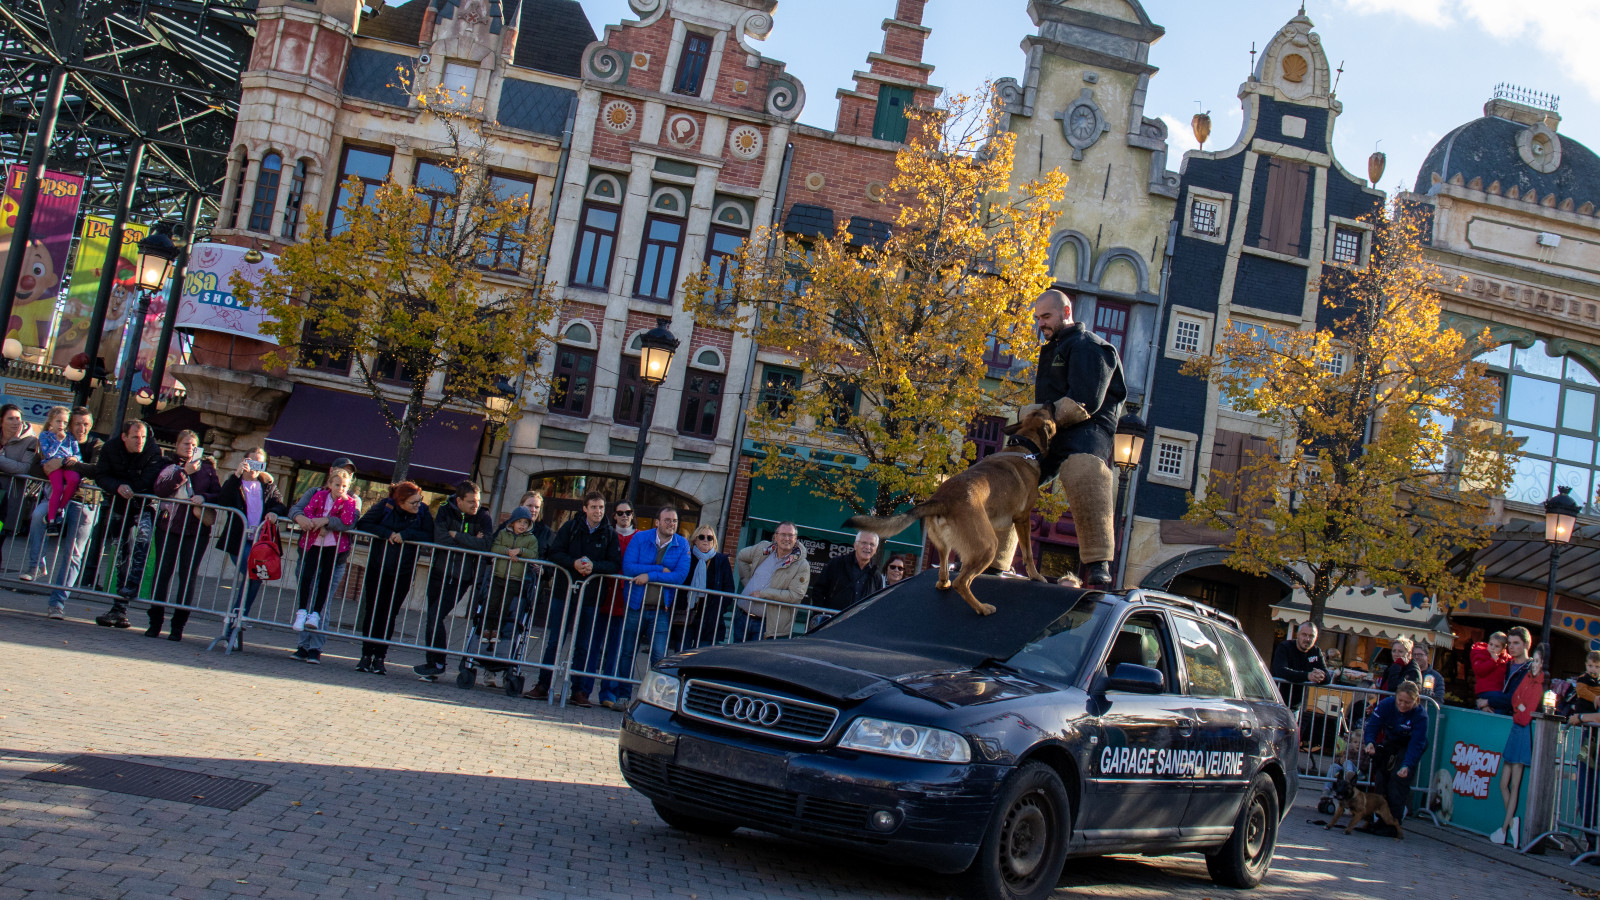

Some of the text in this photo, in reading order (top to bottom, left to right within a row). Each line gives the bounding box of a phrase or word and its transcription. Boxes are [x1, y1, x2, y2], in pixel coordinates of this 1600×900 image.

[1101, 745, 1244, 775] GARAGE SANDRO VEURNE
[1451, 742, 1501, 774] SAMSON
[1452, 770, 1490, 797] MARIE
